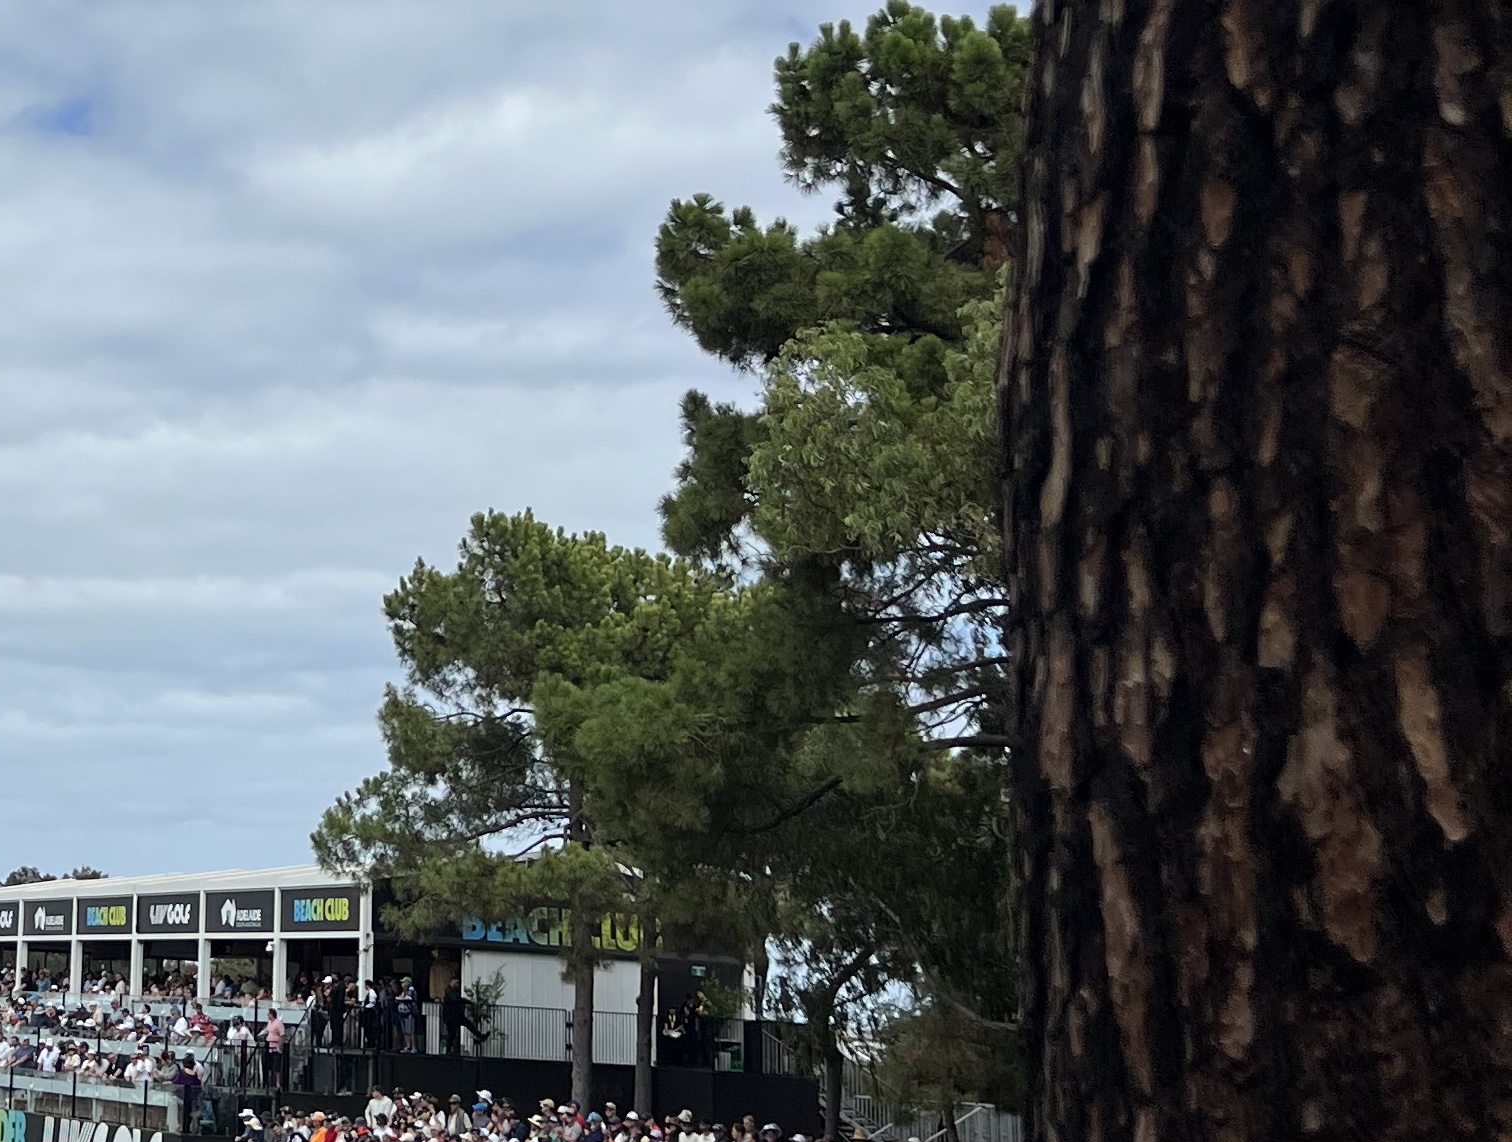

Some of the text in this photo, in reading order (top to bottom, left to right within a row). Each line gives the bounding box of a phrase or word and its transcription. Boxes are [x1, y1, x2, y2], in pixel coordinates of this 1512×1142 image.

[87, 905, 126, 927] BEACH CLUB
[293, 897, 350, 922] BEACH CLUB
[462, 906, 572, 947] BEACH
